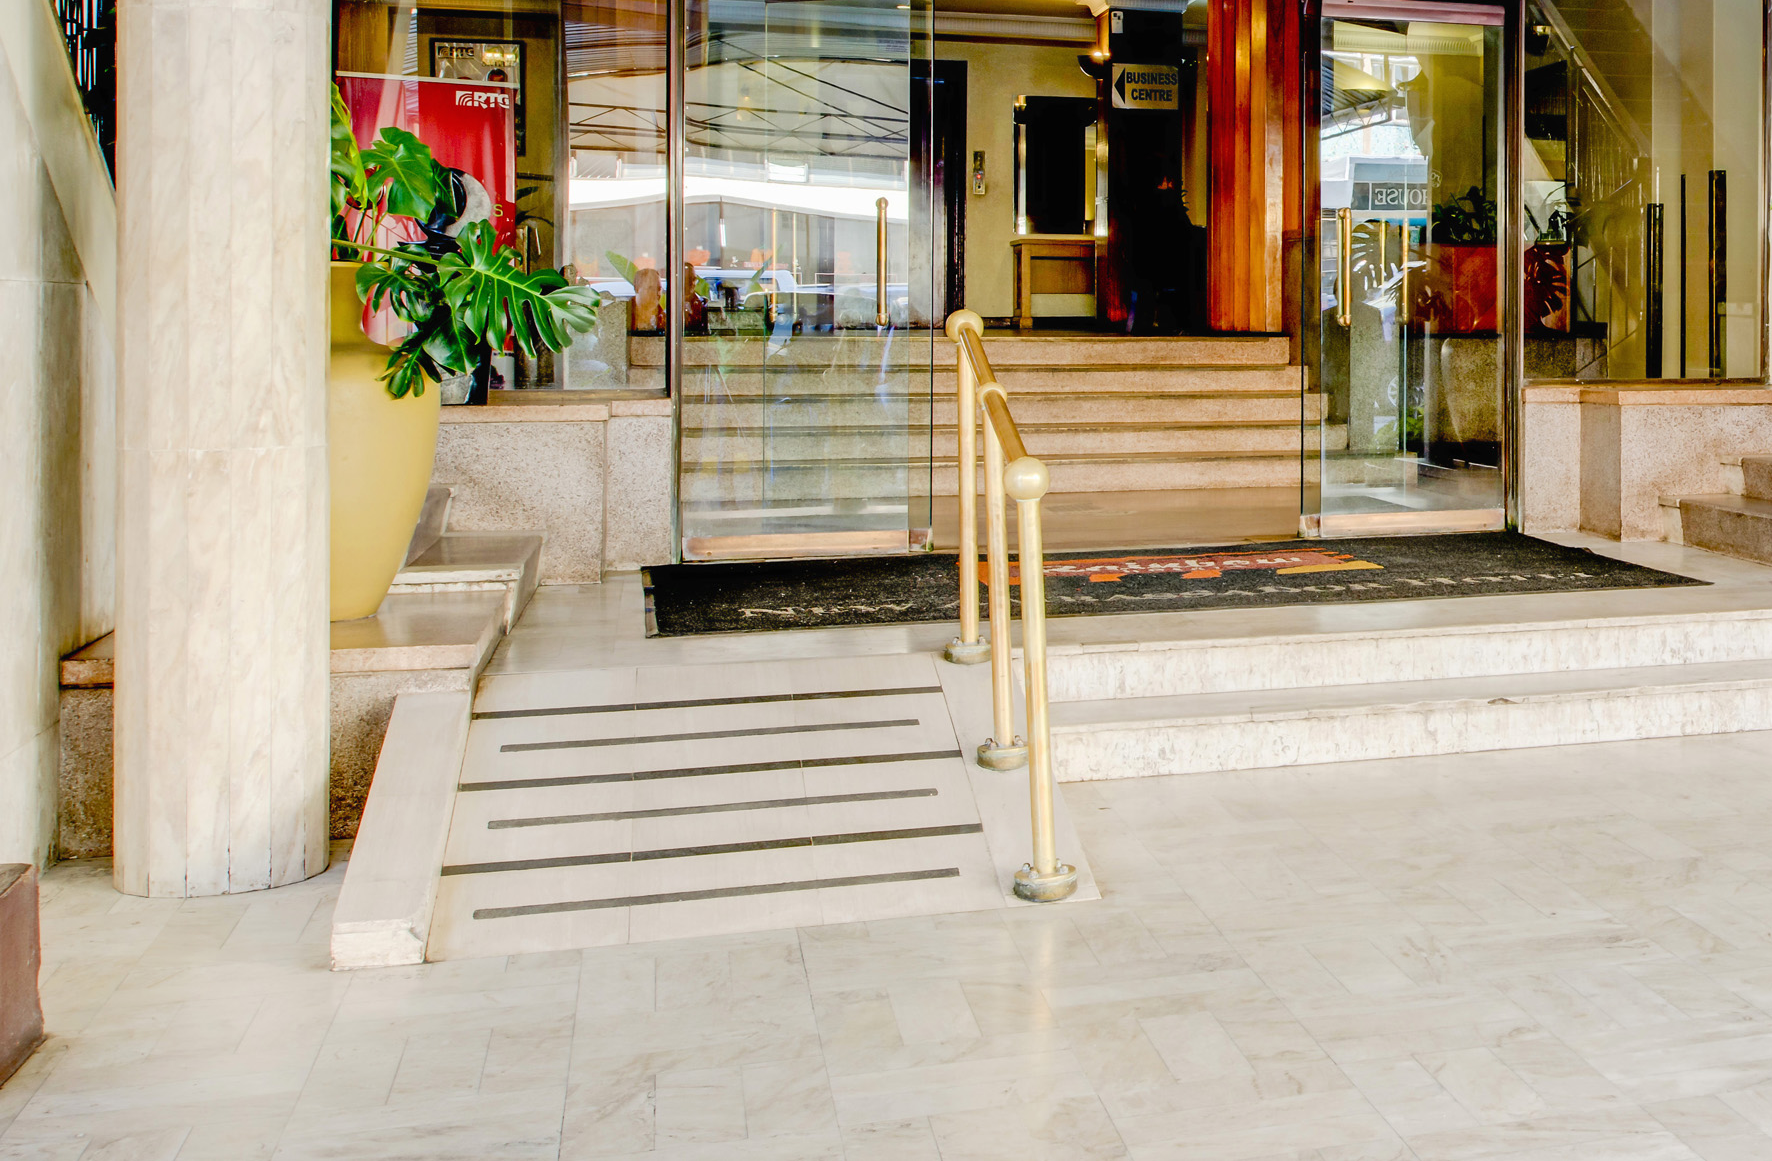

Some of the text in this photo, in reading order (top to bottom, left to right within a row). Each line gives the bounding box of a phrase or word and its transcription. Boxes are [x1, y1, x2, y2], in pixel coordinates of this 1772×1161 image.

[1126, 71, 1178, 85] BUSINESS
[473, 91, 510, 109] RTG
[1131, 88, 1173, 102] CENTRE
